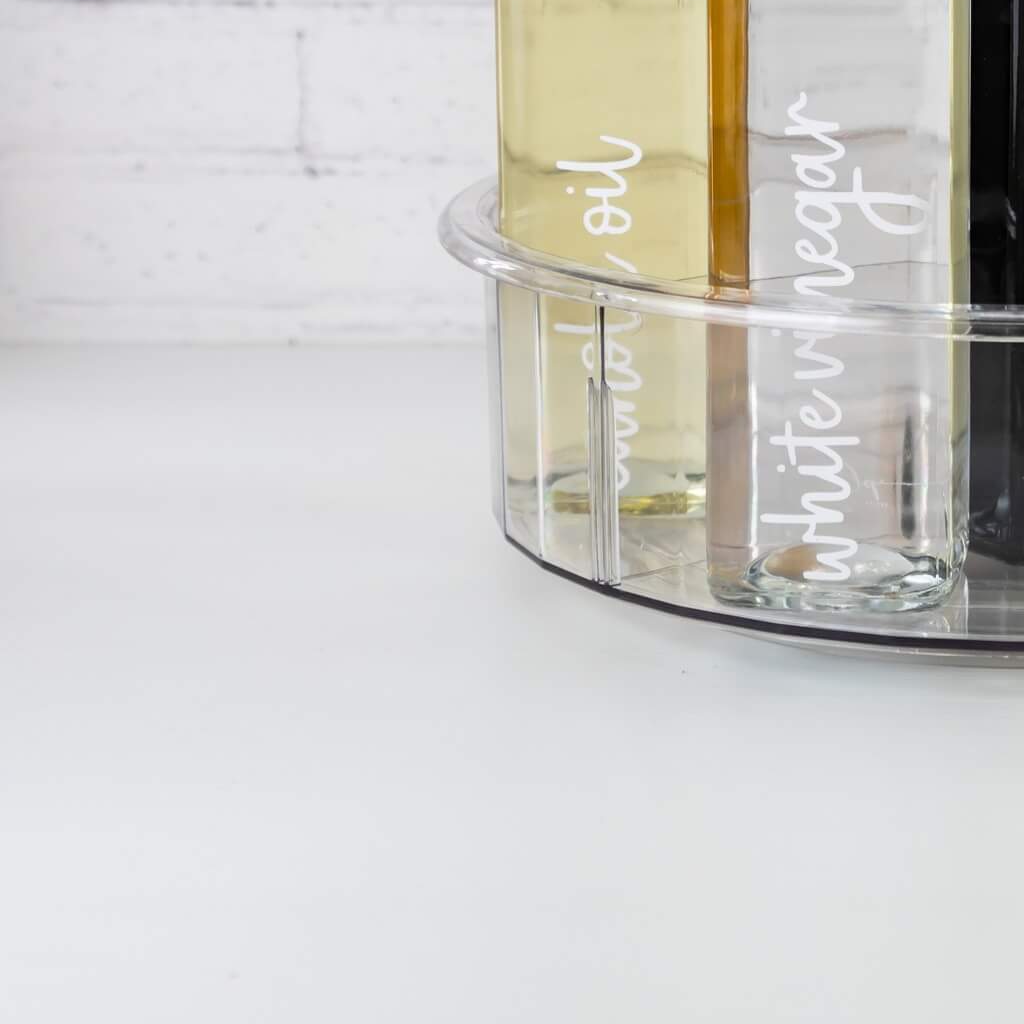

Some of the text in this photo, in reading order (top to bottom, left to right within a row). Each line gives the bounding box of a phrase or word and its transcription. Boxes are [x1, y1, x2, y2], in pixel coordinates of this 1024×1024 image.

[556, 135, 642, 236] oil
[760, 91, 931, 581] white vinegar
